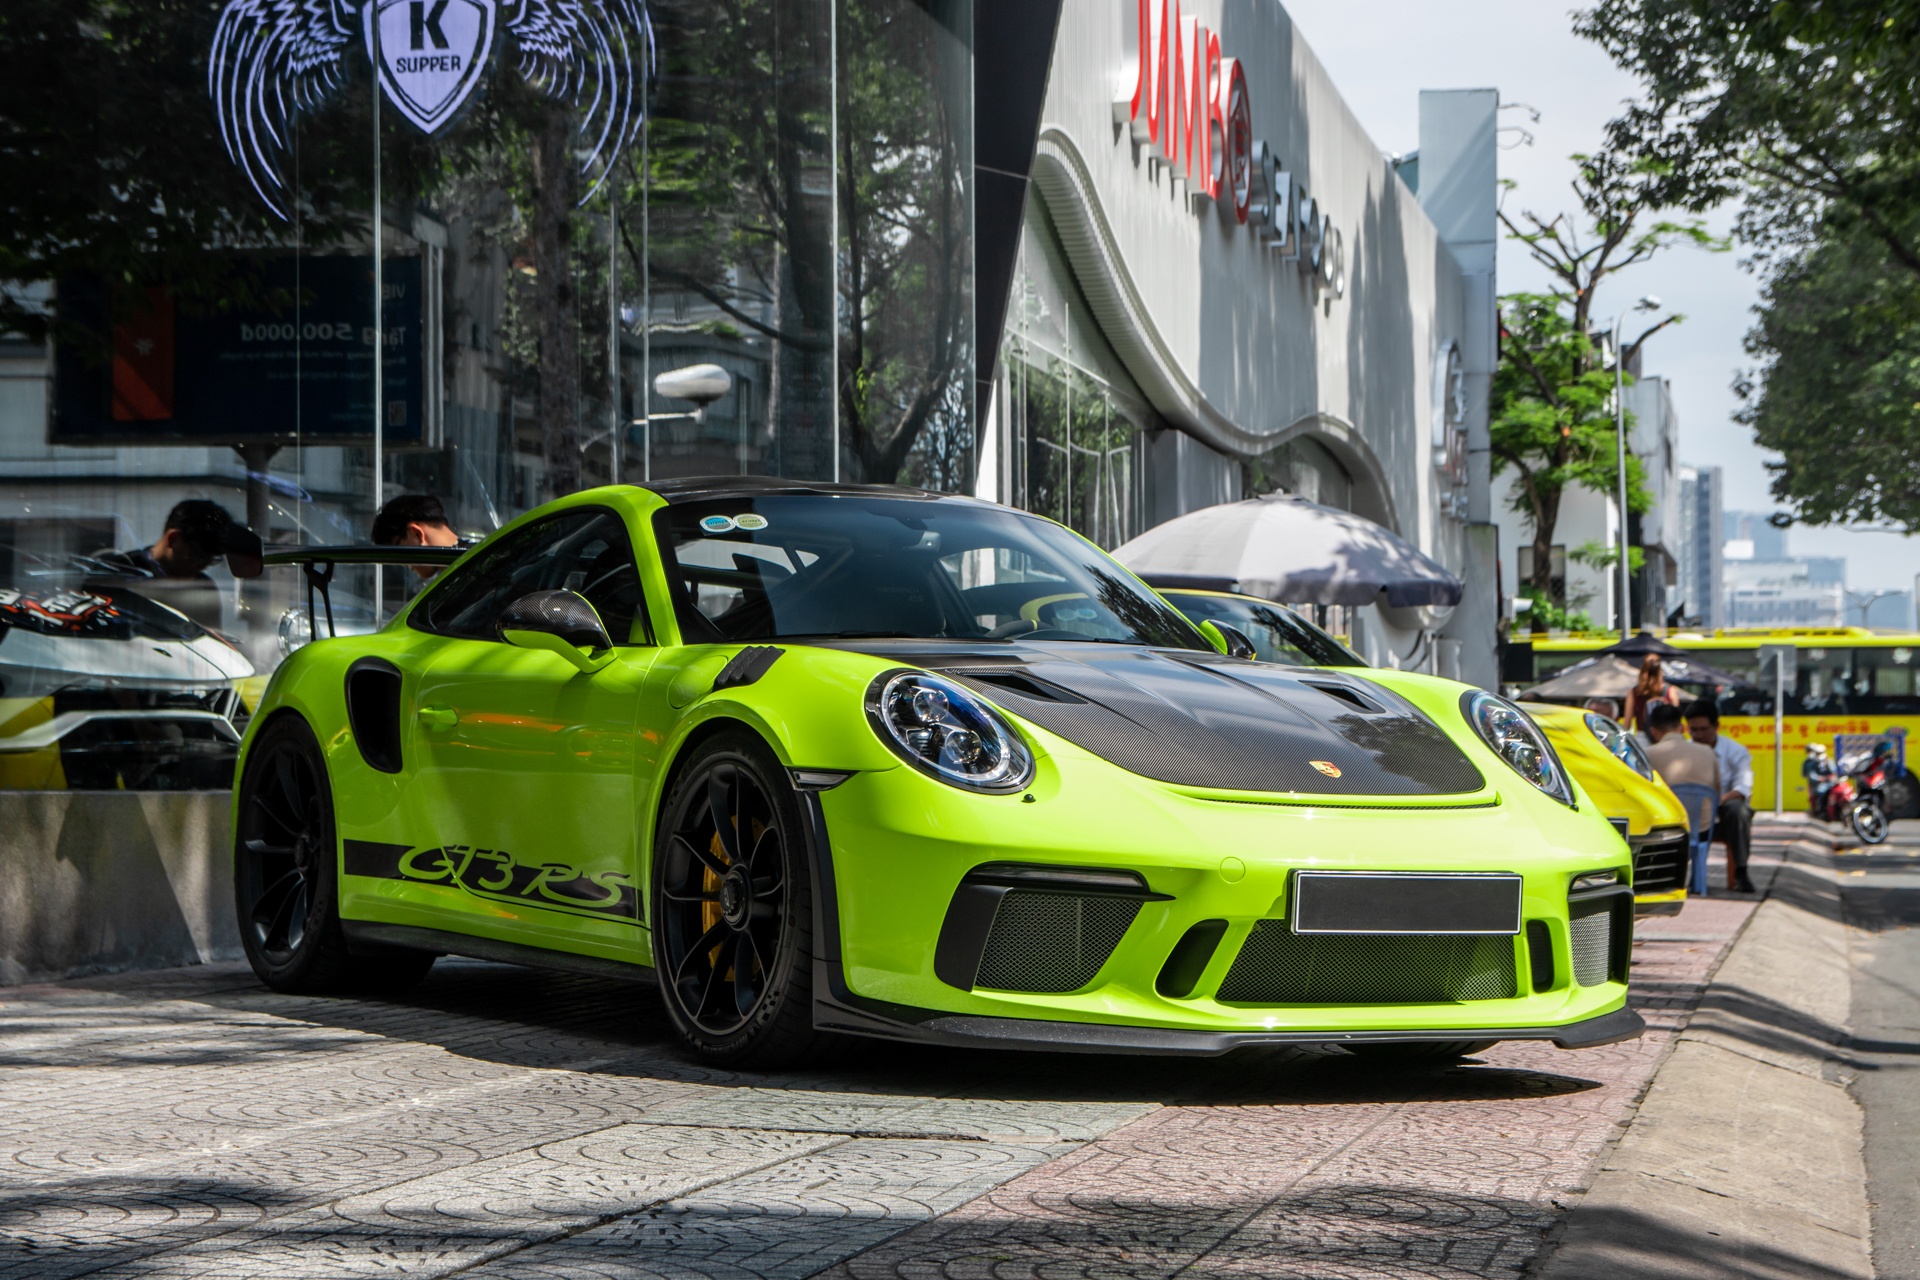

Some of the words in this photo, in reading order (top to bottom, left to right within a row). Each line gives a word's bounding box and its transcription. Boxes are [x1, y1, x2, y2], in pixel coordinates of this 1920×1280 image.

[410, 0, 450, 50] K
[396, 55, 462, 73] SUPPER
[398, 844, 517, 891] GT3
[520, 862, 631, 908] RS
